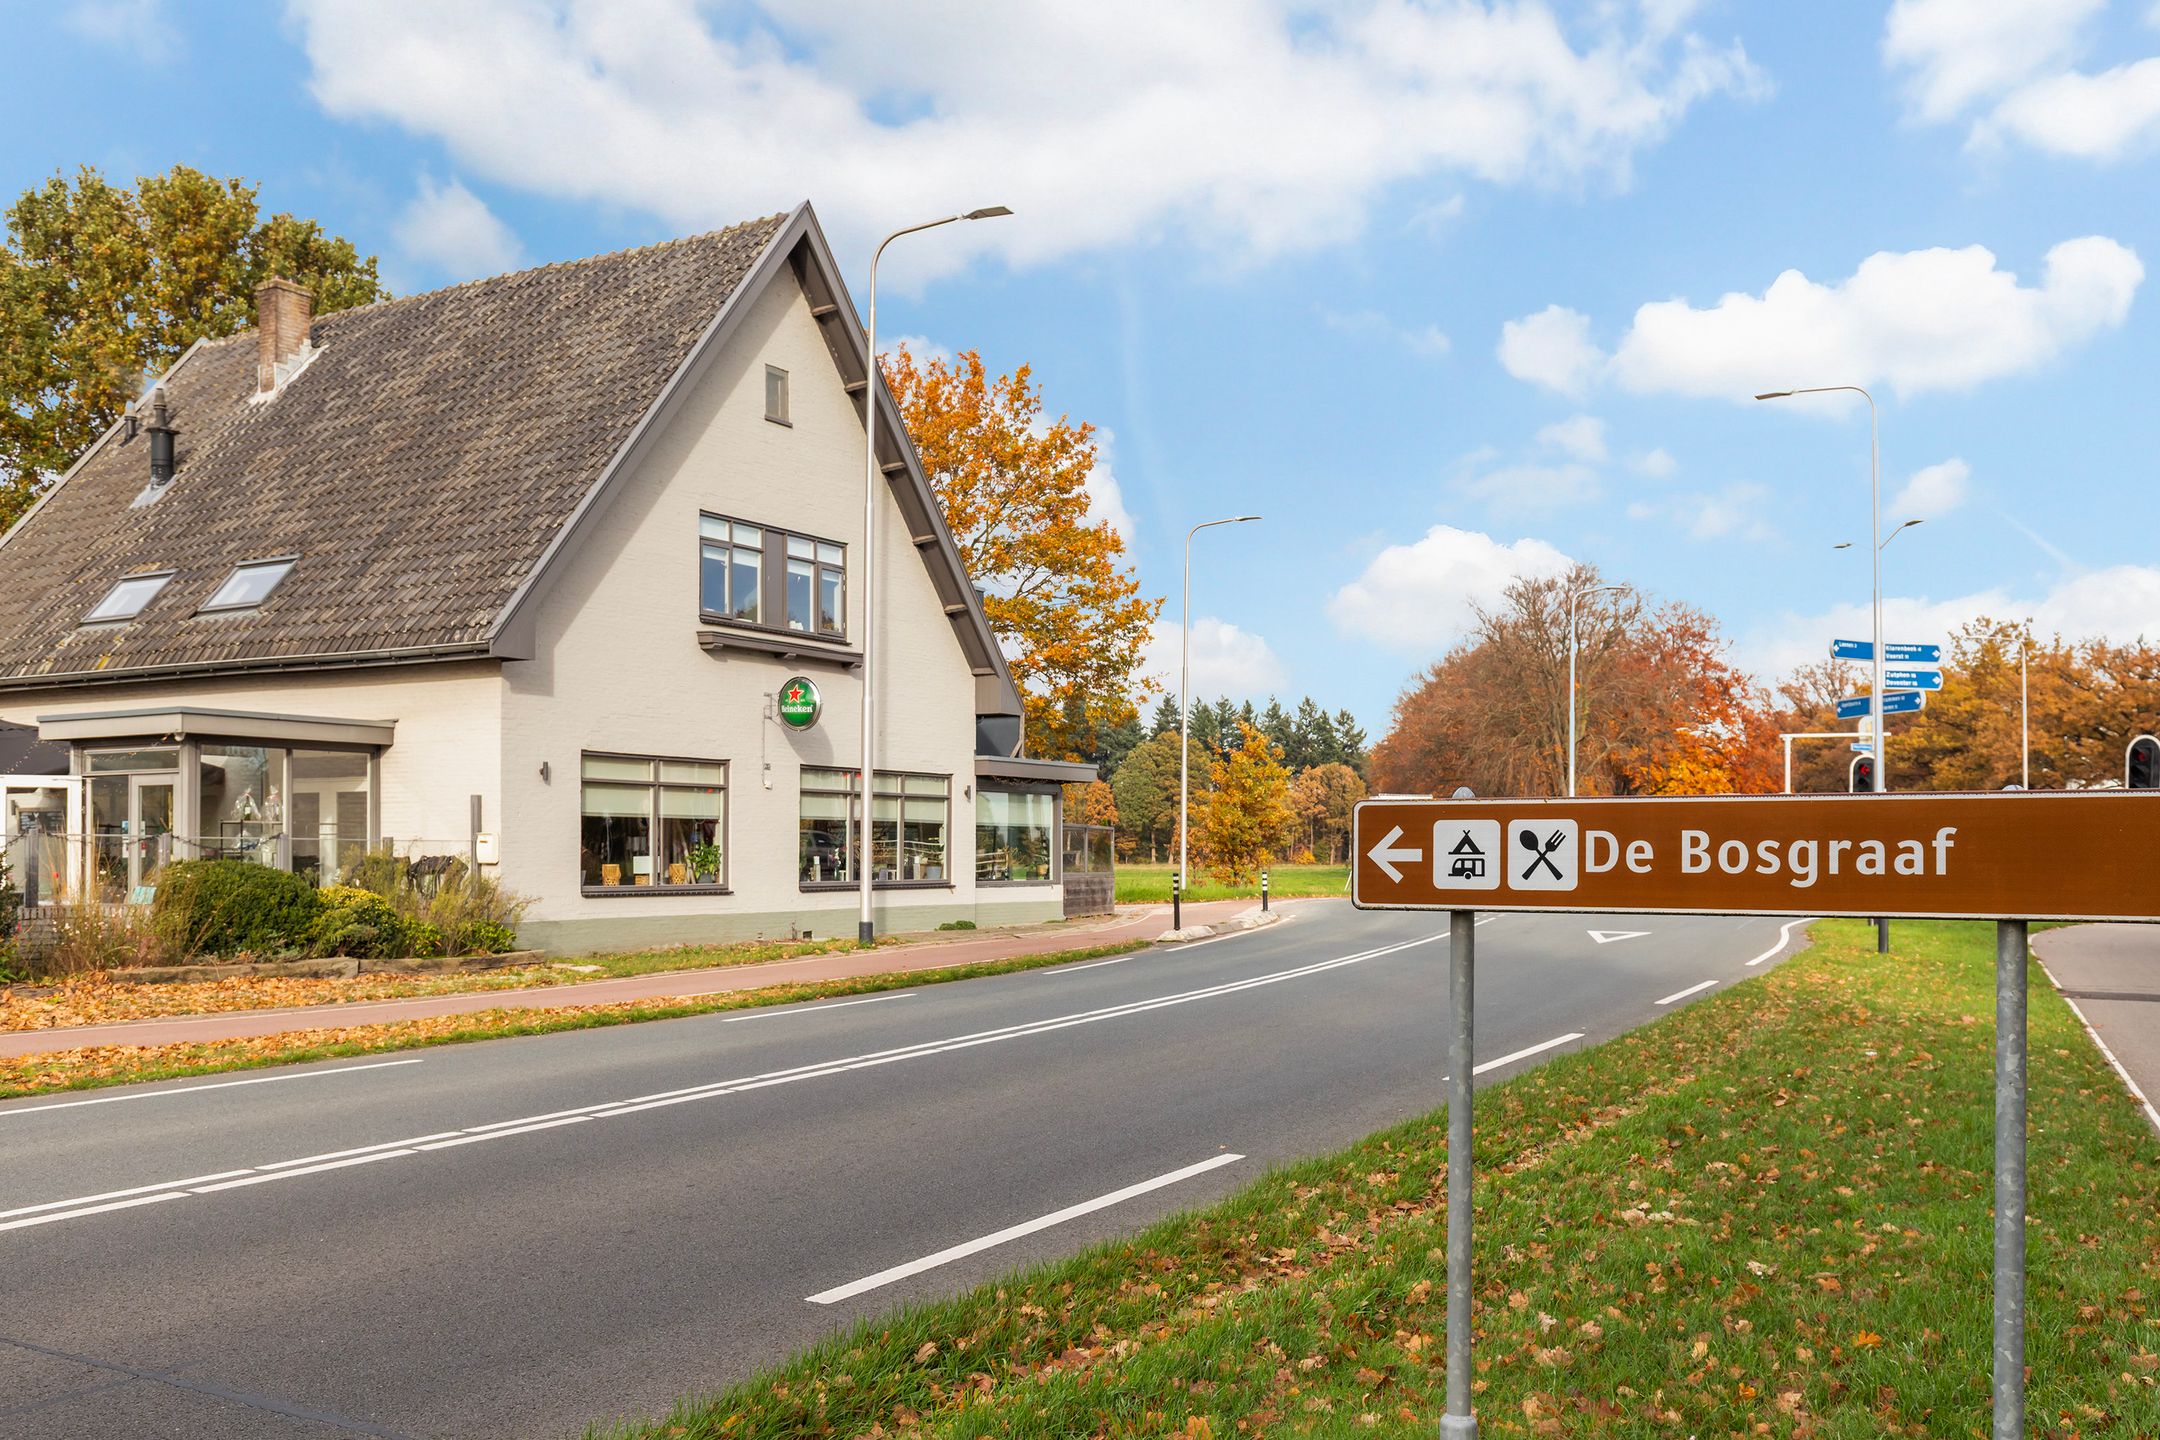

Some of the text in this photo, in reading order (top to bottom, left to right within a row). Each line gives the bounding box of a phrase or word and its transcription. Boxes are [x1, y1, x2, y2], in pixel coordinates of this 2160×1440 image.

[781, 704, 813, 713] Heineken
[1585, 826, 1958, 888] De Bosgraaf
